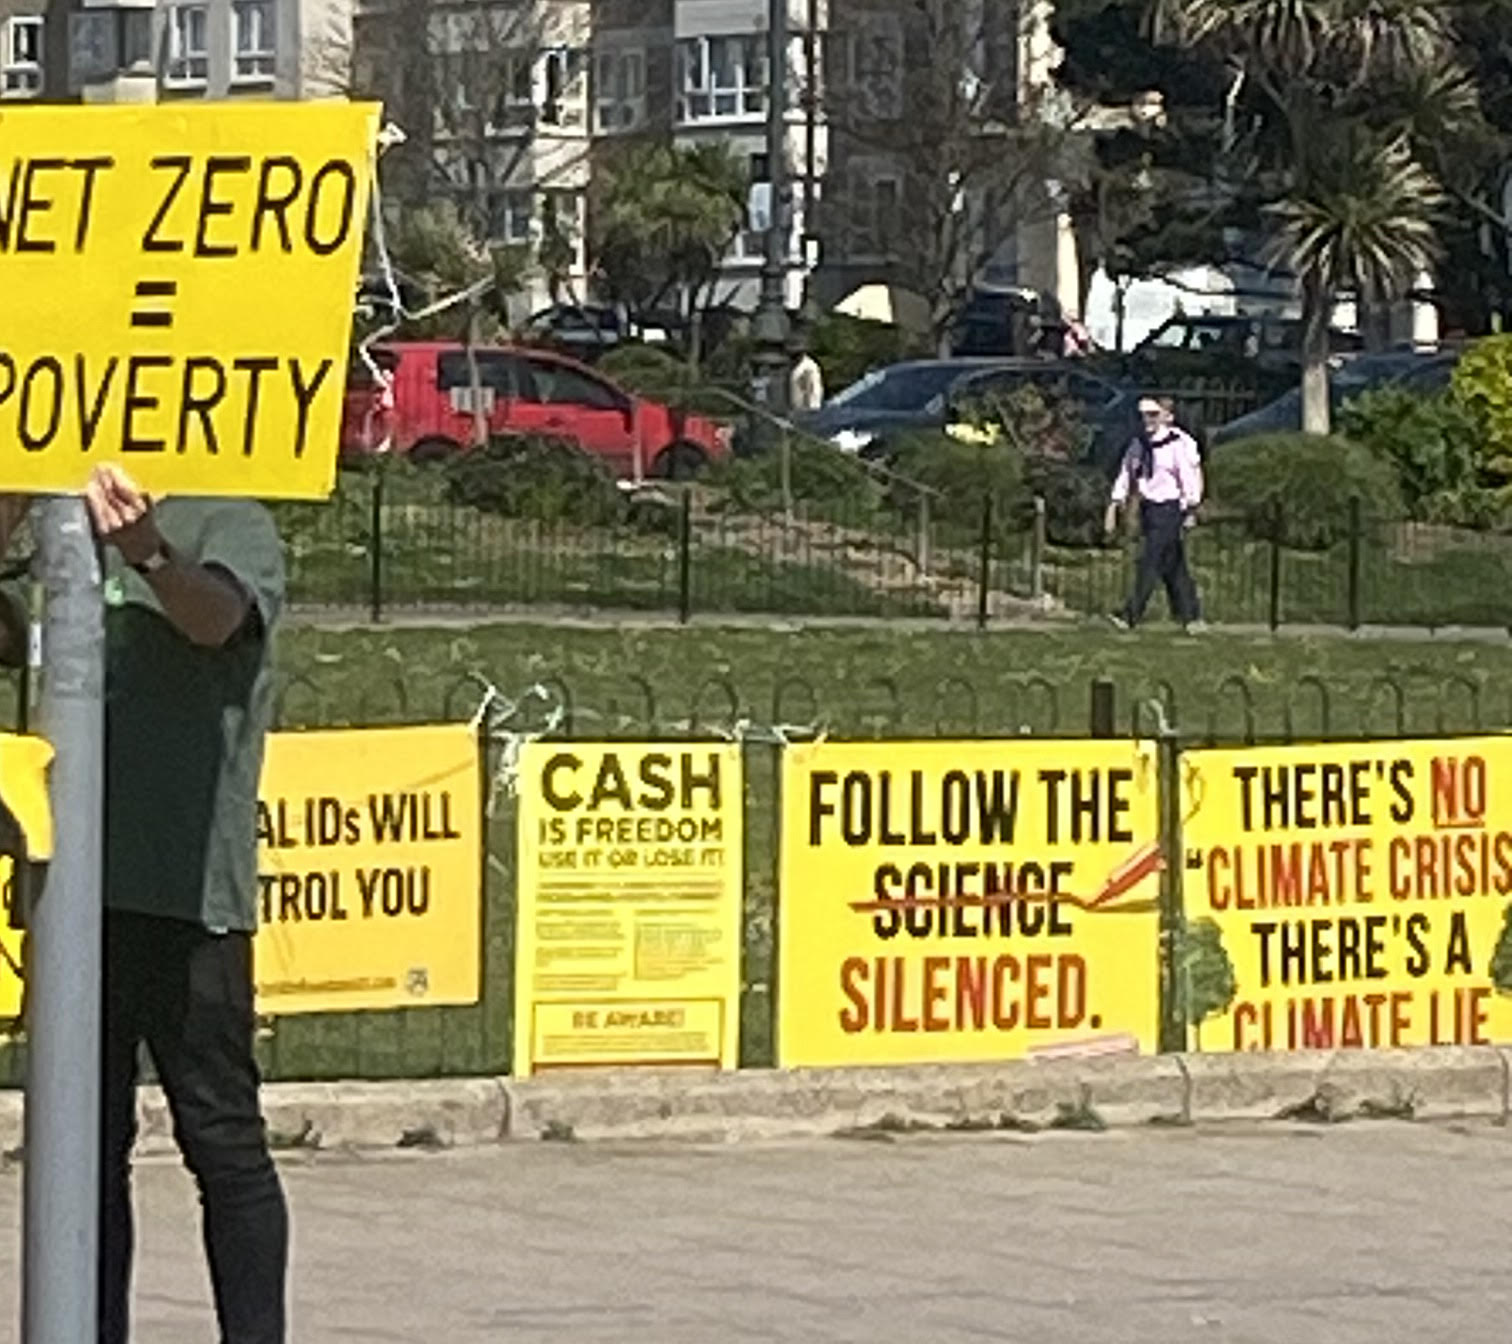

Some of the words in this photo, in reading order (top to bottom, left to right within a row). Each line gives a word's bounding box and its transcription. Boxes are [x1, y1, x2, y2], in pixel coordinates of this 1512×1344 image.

[141, 156, 356, 257] ZERO
[305, 797, 361, 847] IDs
[369, 790, 461, 844] WILL
[541, 752, 722, 812] CASH
[809, 769, 1020, 847] FOLLOW
[1038, 768, 1134, 843] THE
[1233, 759, 1415, 832] THERE'S
[1430, 755, 1486, 826] NO
[538, 817, 566, 845] IS
[576, 817, 723, 845] FREEDOM
[1389, 830, 1512, 901] CRISIS
[257, 869, 348, 923] TROL
[355, 866, 430, 918] YOU
[872, 861, 1075, 939] SCIENCE
[1251, 913, 1431, 988] THERE'S
[1444, 911, 1472, 975] A
[838, 954, 1102, 1033] SILENCED.
[1234, 992, 1413, 1050] CLIMATE
[1430, 987, 1492, 1047] LIE
